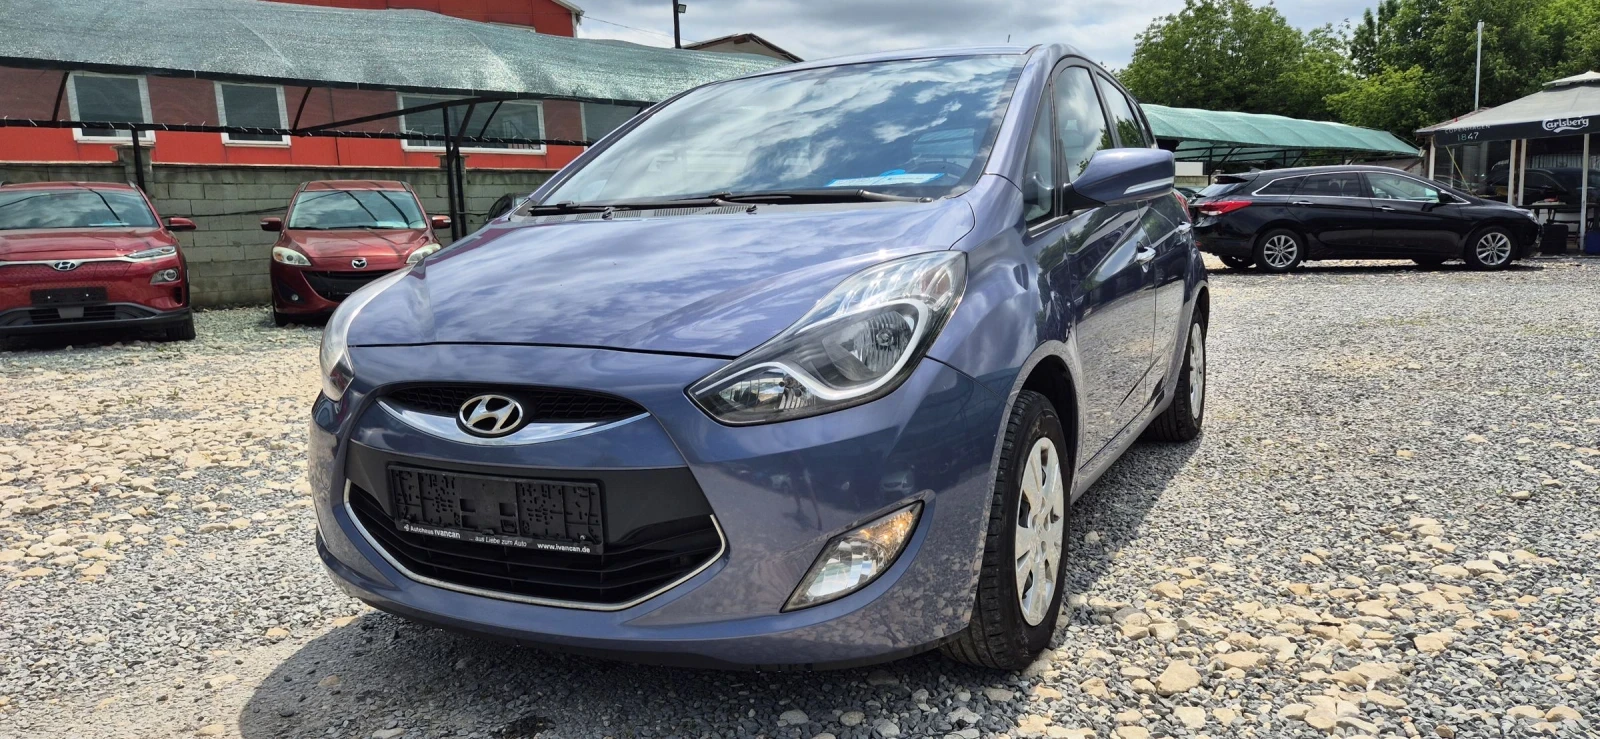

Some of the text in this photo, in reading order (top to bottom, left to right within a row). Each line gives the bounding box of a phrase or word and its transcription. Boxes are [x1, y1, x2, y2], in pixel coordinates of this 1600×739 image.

[1541, 117, 1589, 133] Carlsberg
[1457, 131, 1479, 141] 1847
[485, 536, 501, 544] Liebe
[513, 539, 528, 548] Auto
[537, 543, 591, 554] www.ivancan.de
